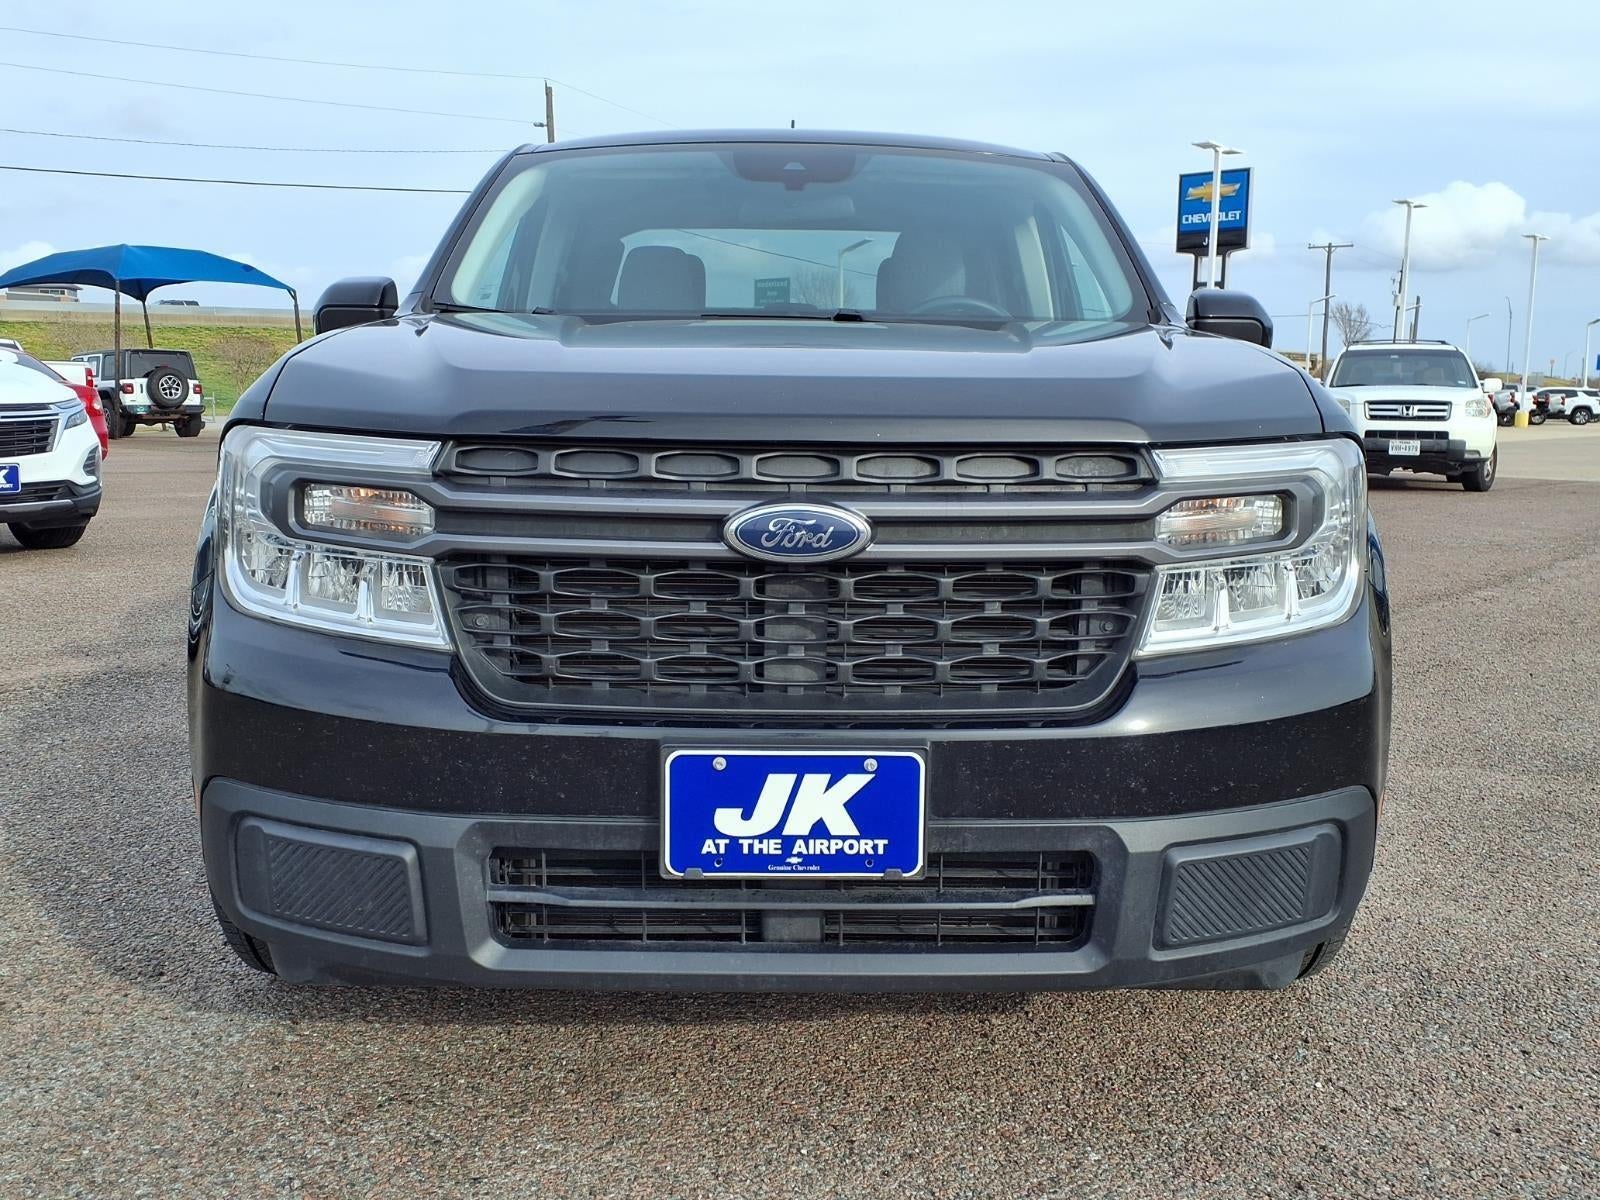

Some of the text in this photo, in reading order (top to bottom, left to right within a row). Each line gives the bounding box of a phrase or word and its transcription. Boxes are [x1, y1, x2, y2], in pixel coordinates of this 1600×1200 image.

[1182, 210, 1242, 225] CHEVOLET
[760, 517, 835, 549] Ford
[713, 773, 877, 838] JK
[701, 839, 889, 855] AT THE AIRPORT
